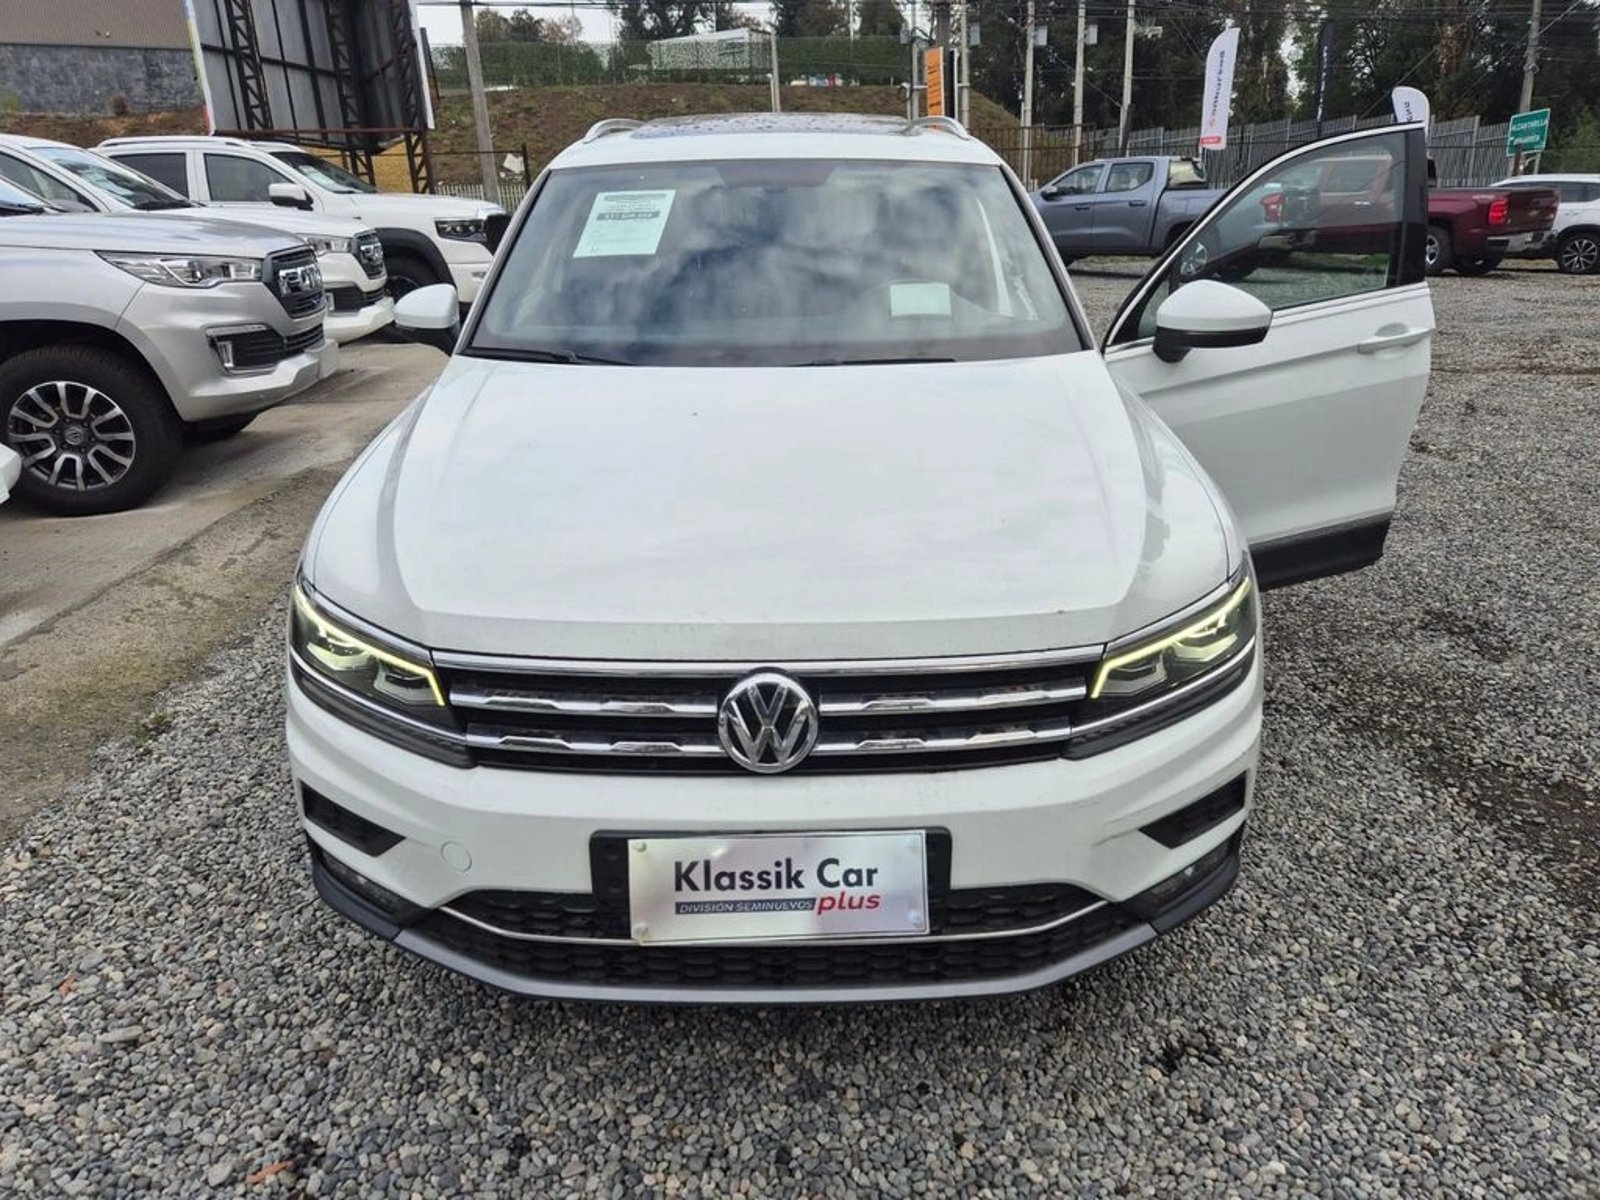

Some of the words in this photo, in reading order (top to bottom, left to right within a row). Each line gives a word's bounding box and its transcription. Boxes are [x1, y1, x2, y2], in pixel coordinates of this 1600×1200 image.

[674, 858, 805, 891] Klassik
[816, 857, 878, 888] Car
[736, 900, 814, 911] SEMINUEVOS
[817, 891, 881, 915] plus
